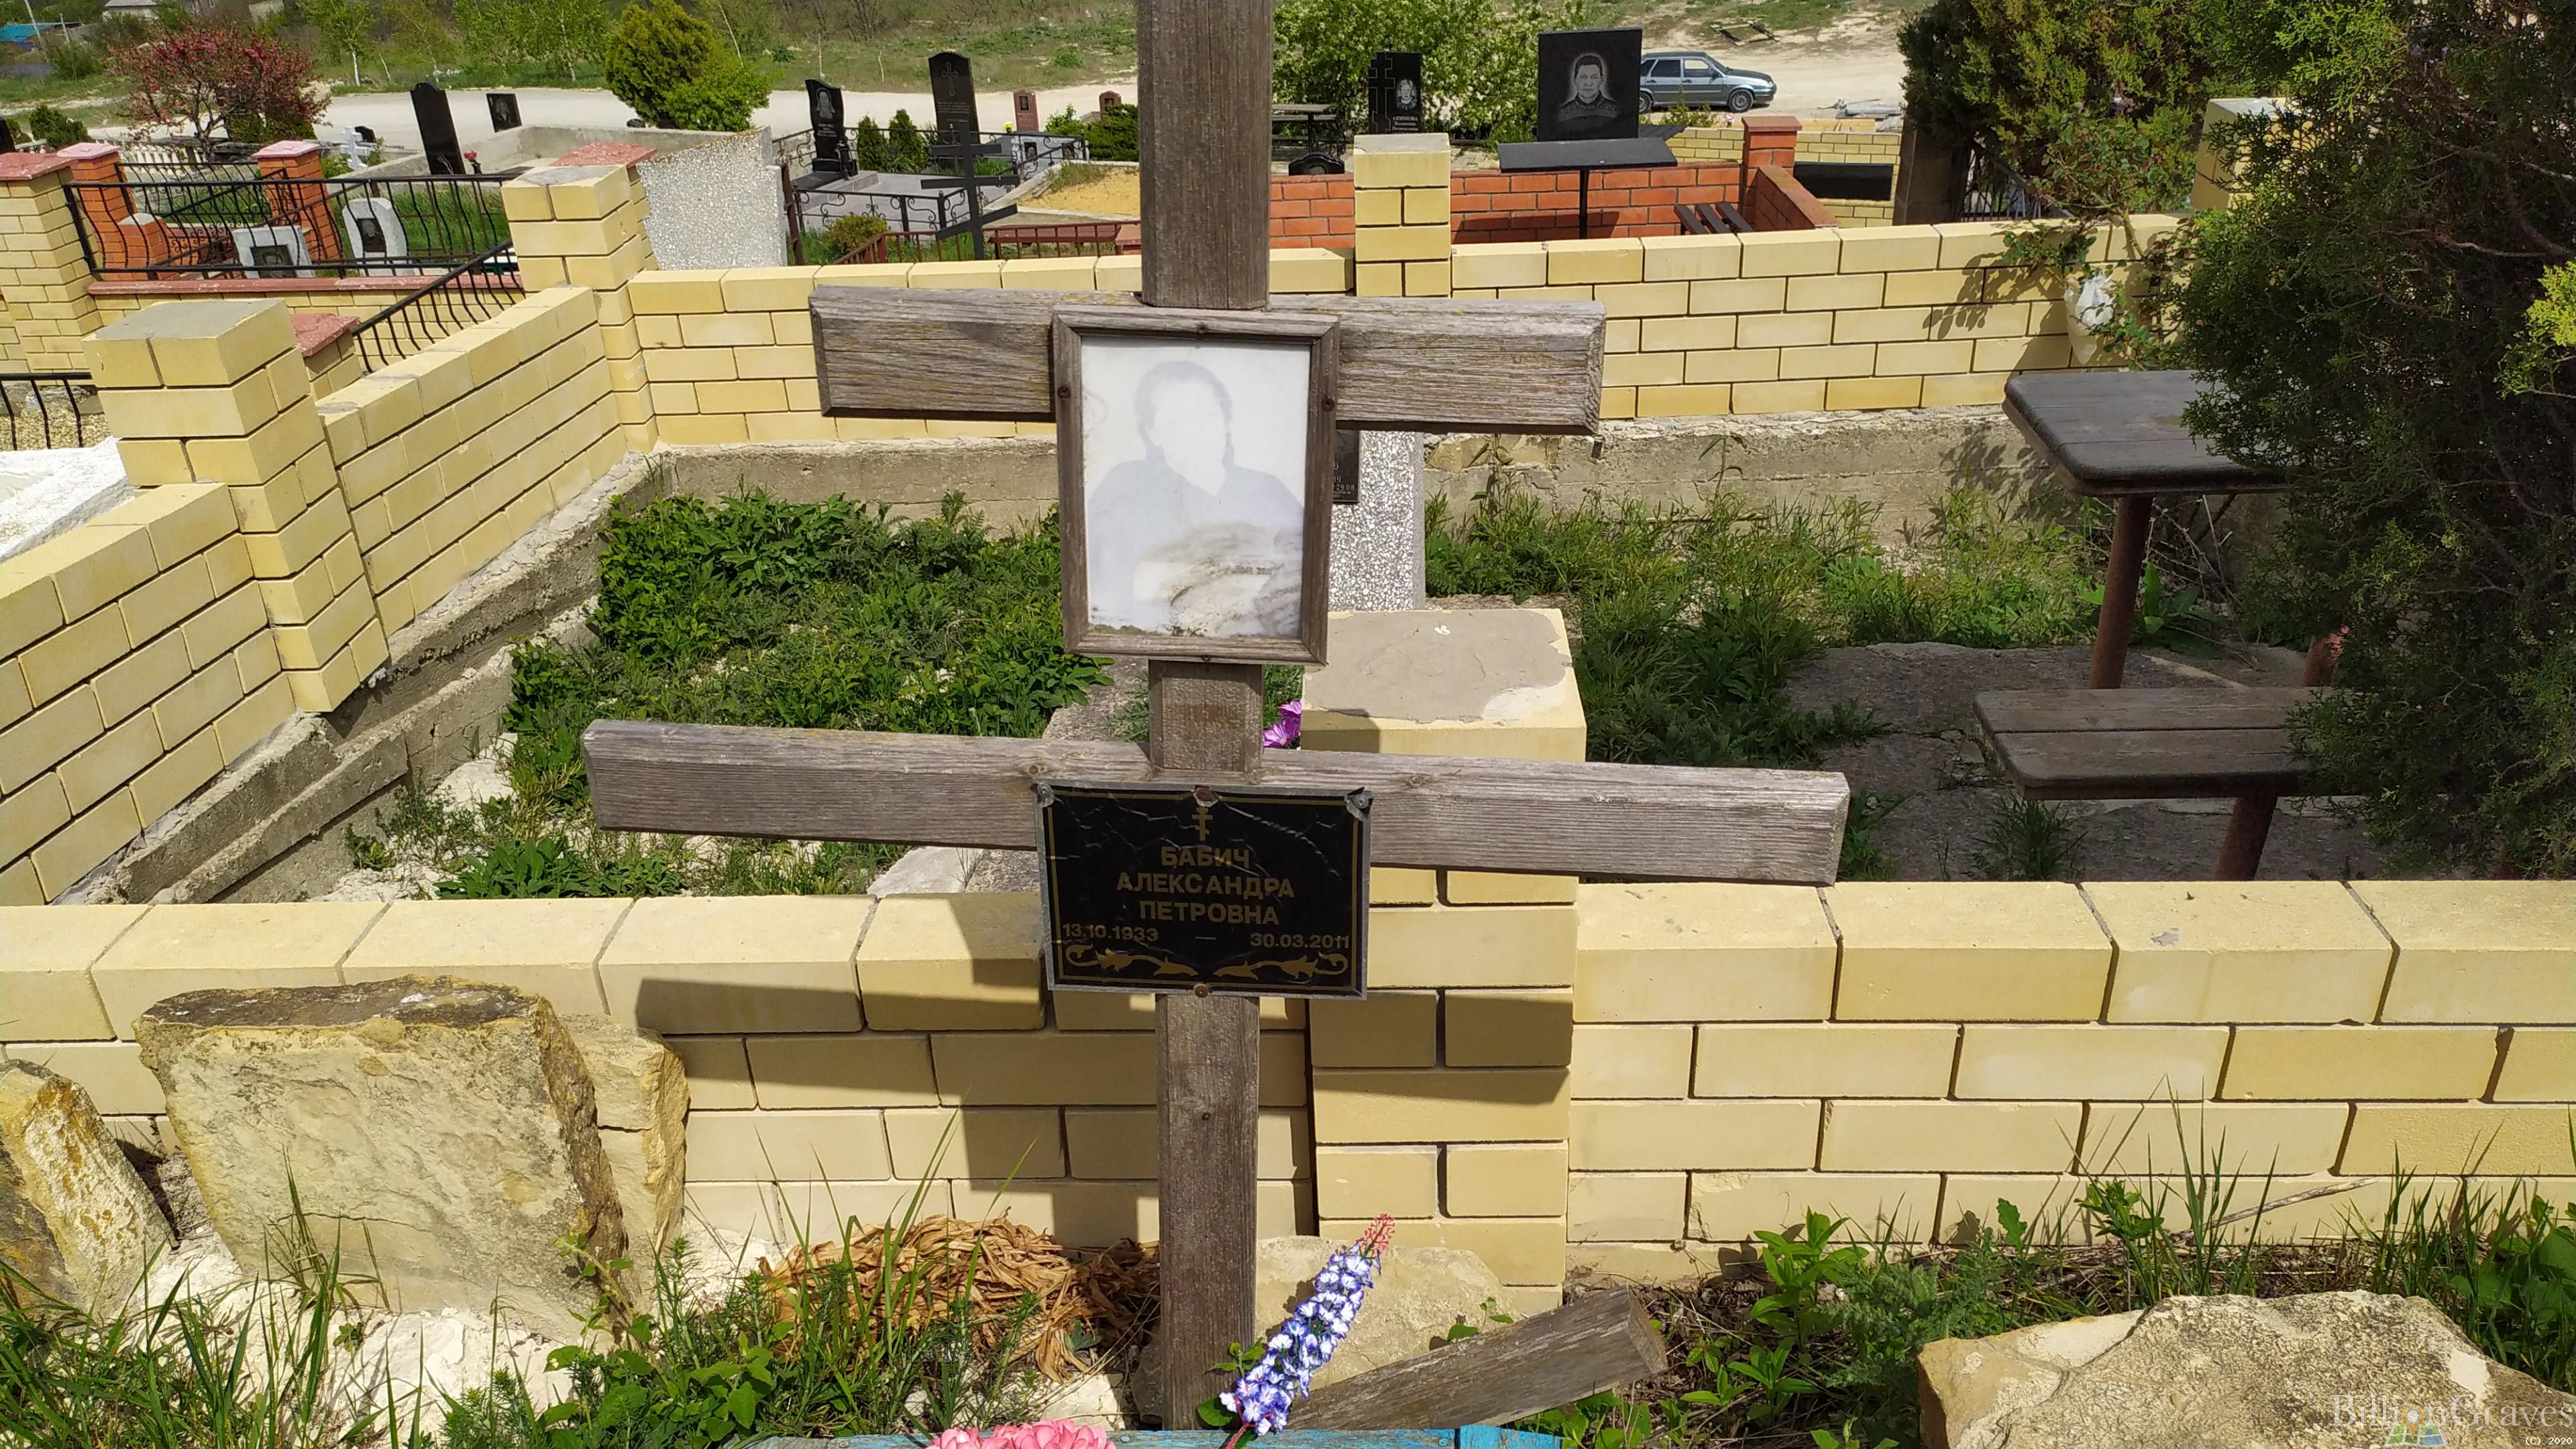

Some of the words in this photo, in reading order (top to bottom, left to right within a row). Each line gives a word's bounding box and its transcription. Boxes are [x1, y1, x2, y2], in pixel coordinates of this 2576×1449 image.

[1161, 846, 1250, 869] БАБИЧ
[1116, 872, 1295, 900] АЛЕКСАНДРА
[1139, 900, 1280, 926] ПЕТРОВНА
[1063, 923, 1159, 941] 13.10.1933
[1250, 932, 1349, 949] 30.03.2011
